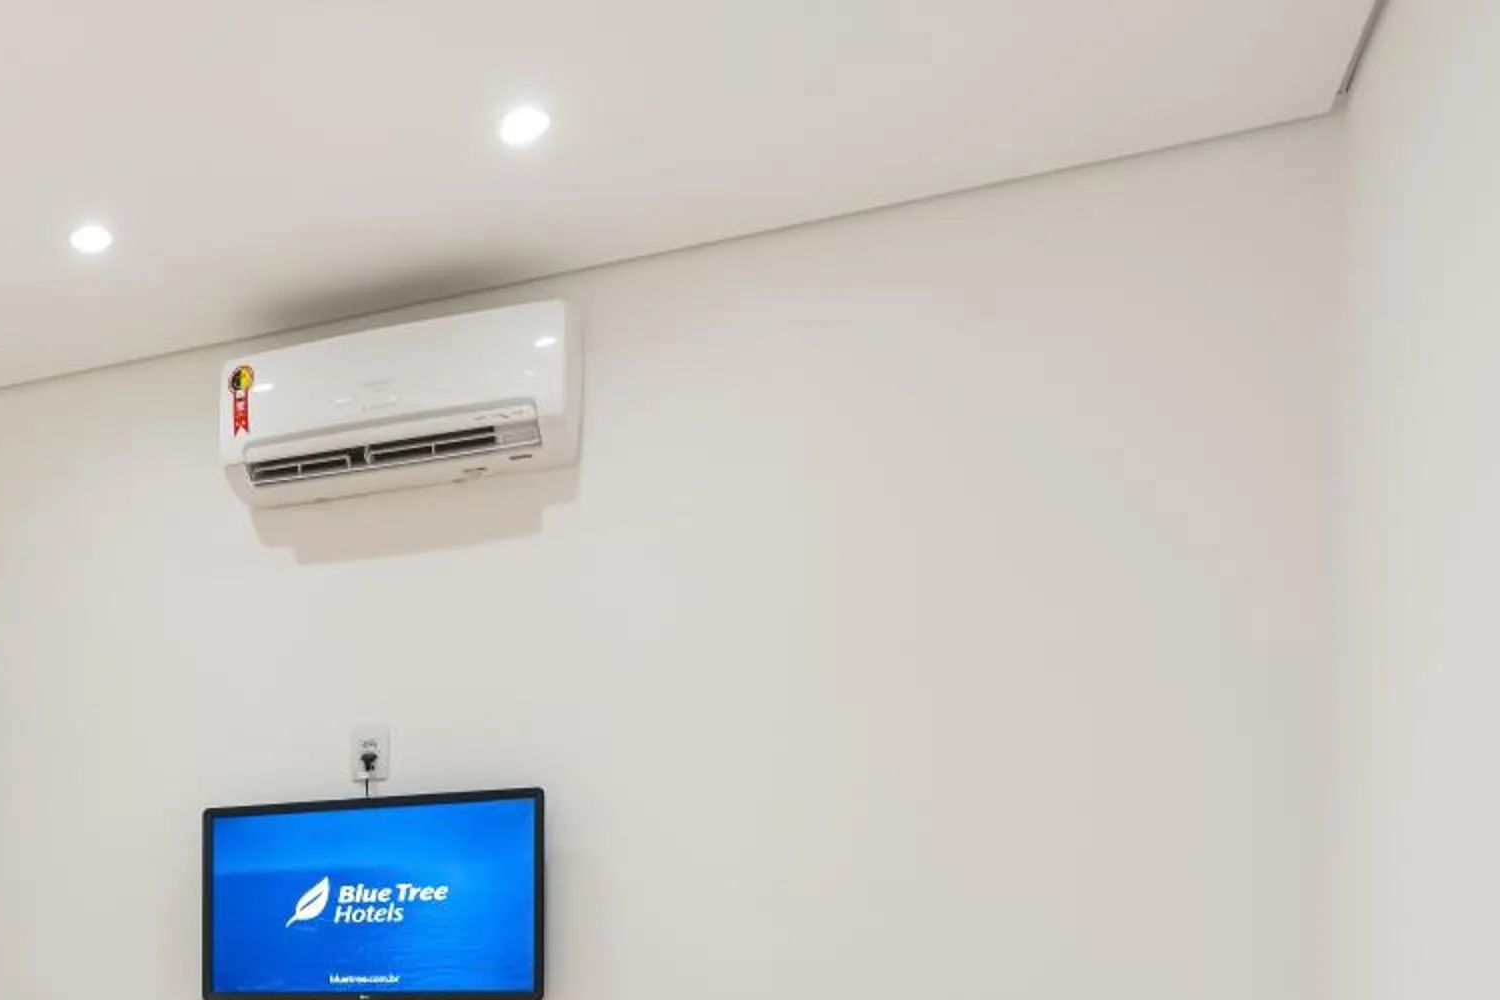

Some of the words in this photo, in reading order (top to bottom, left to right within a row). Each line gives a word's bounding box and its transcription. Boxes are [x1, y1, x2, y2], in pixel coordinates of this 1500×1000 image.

[338, 883, 393, 903] Blue
[396, 883, 449, 902] Tree
[334, 902, 405, 924] Hotels
